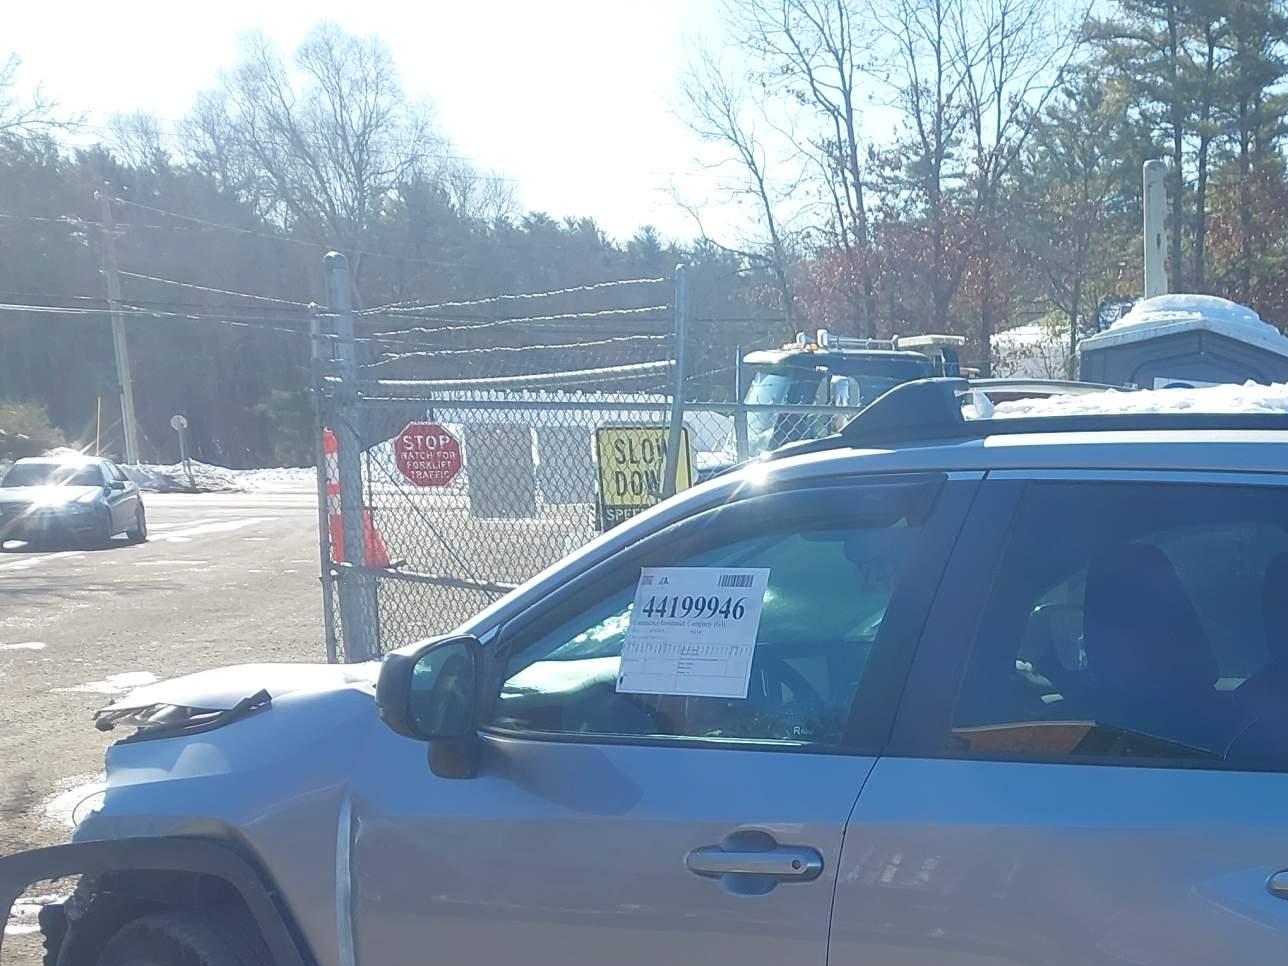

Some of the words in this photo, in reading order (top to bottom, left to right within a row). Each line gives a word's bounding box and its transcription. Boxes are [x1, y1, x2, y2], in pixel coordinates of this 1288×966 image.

[403, 435, 450, 450] STOP
[401, 451, 433, 460] WATCH
[436, 451, 456, 460] FOR
[406, 460, 452, 469] FORKLIFT
[410, 470, 450, 479] TRAFFIC
[614, 470, 661, 497] DOW
[606, 508, 647, 521] SPEE
[642, 595, 747, 620] 44199946
